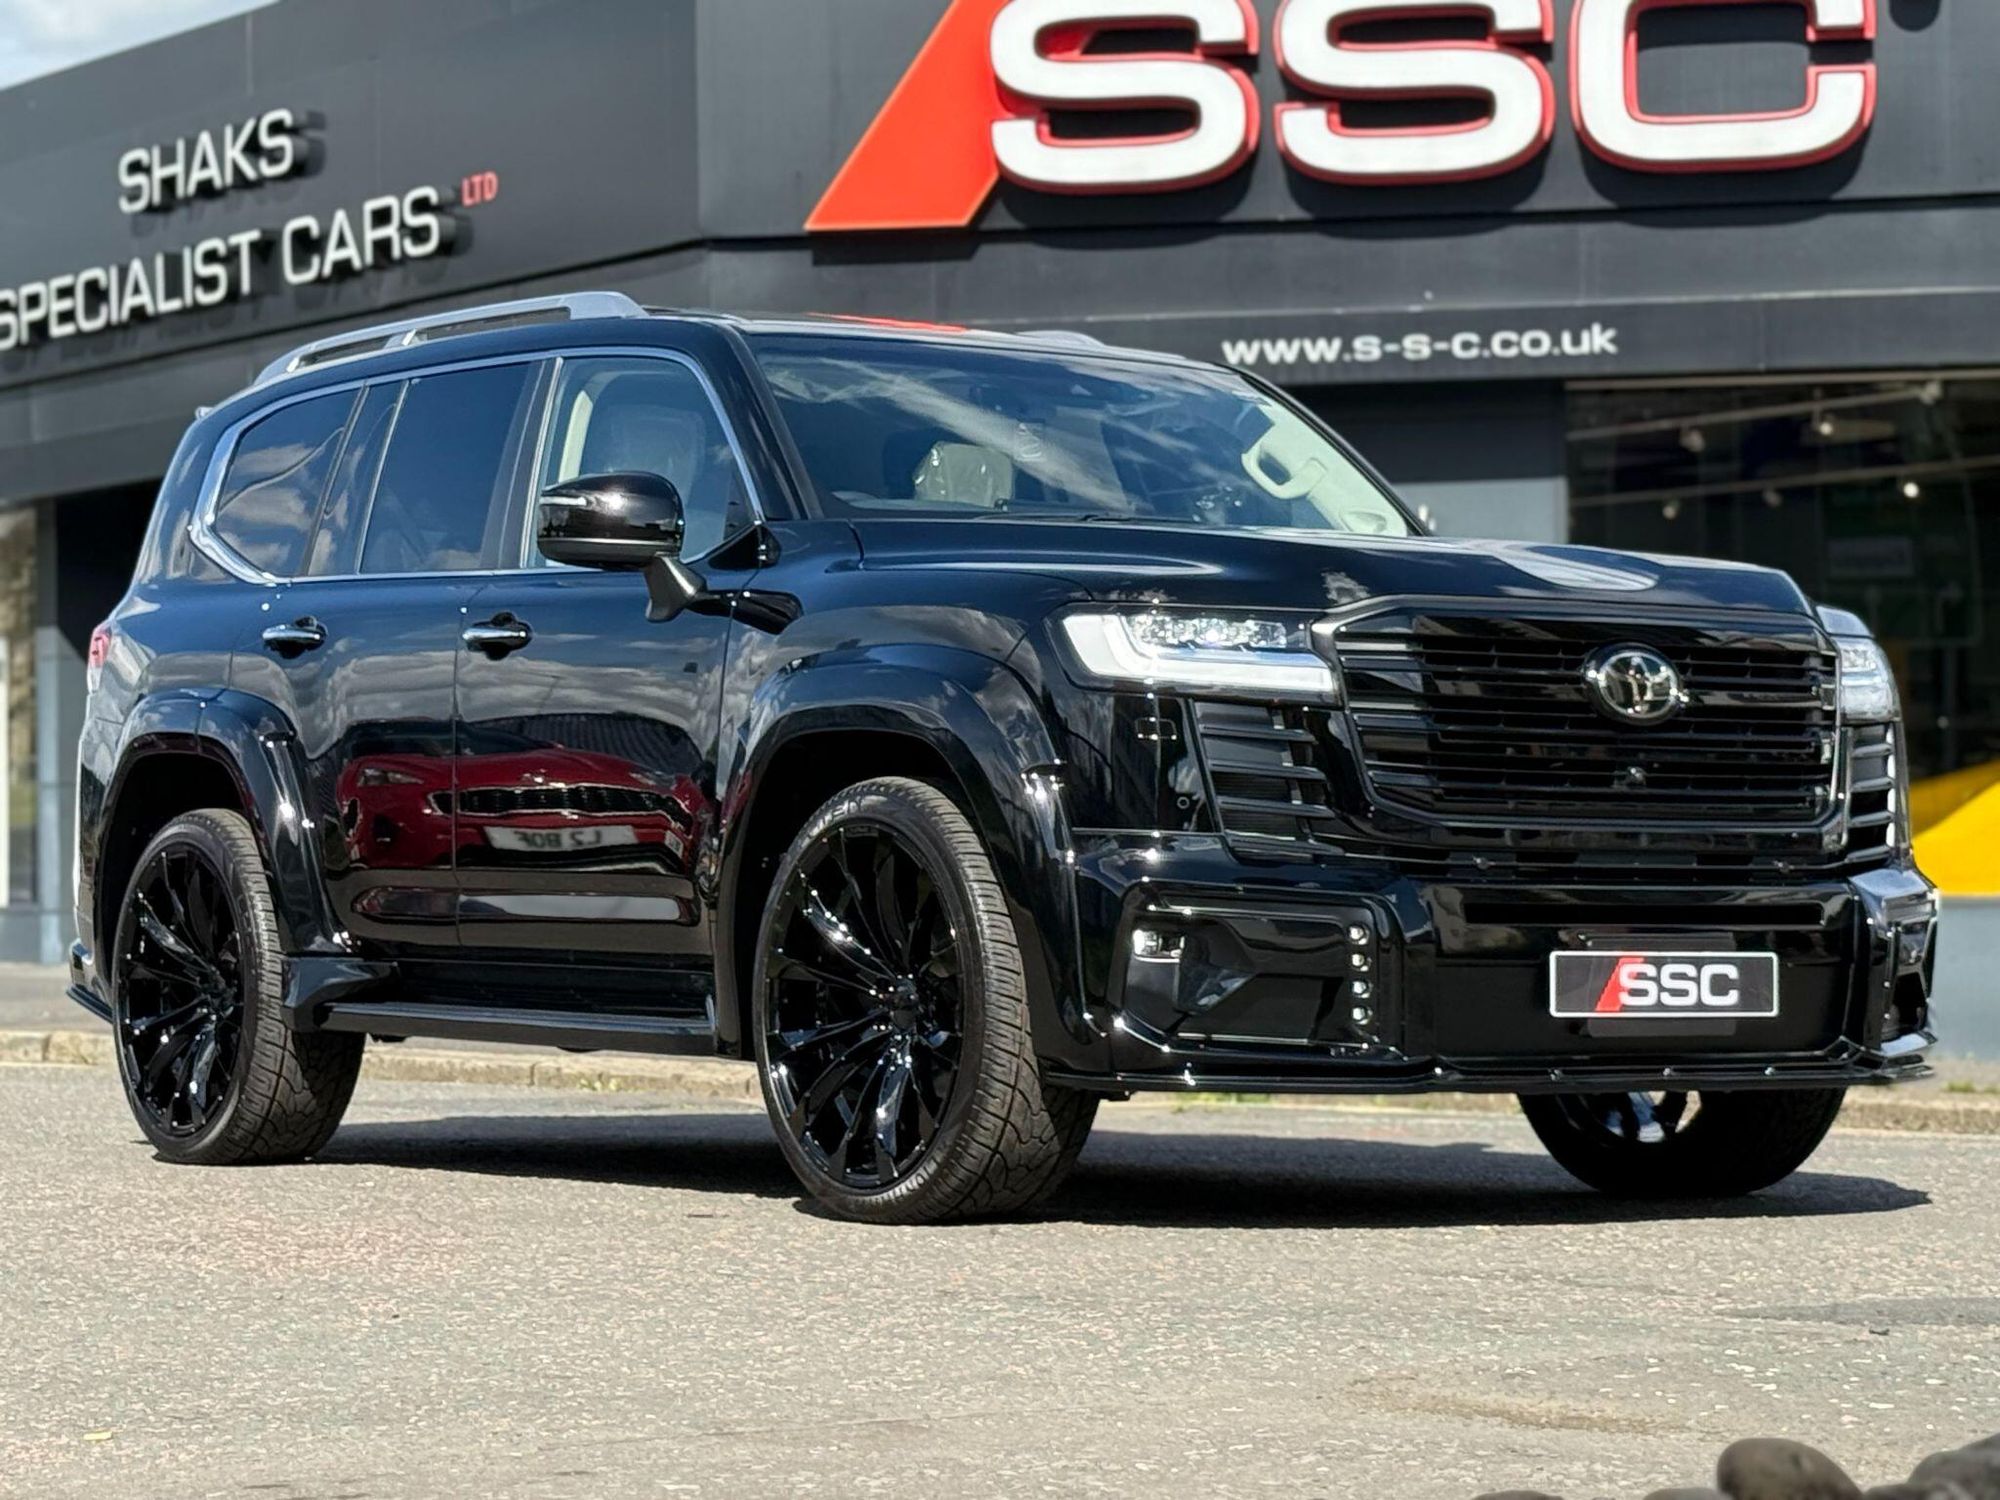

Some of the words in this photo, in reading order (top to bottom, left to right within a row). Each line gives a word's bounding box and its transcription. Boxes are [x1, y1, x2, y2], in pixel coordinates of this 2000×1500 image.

[990, 0, 1876, 193] SSC
[118, 108, 295, 214] SHAKS
[0, 229, 262, 351] SPECIALIST
[281, 186, 440, 285] CARS
[461, 171, 498, 206] LTD
[1222, 322, 1618, 364] www.s-s-c.co.uk
[1618, 963, 1740, 1006] SSC
